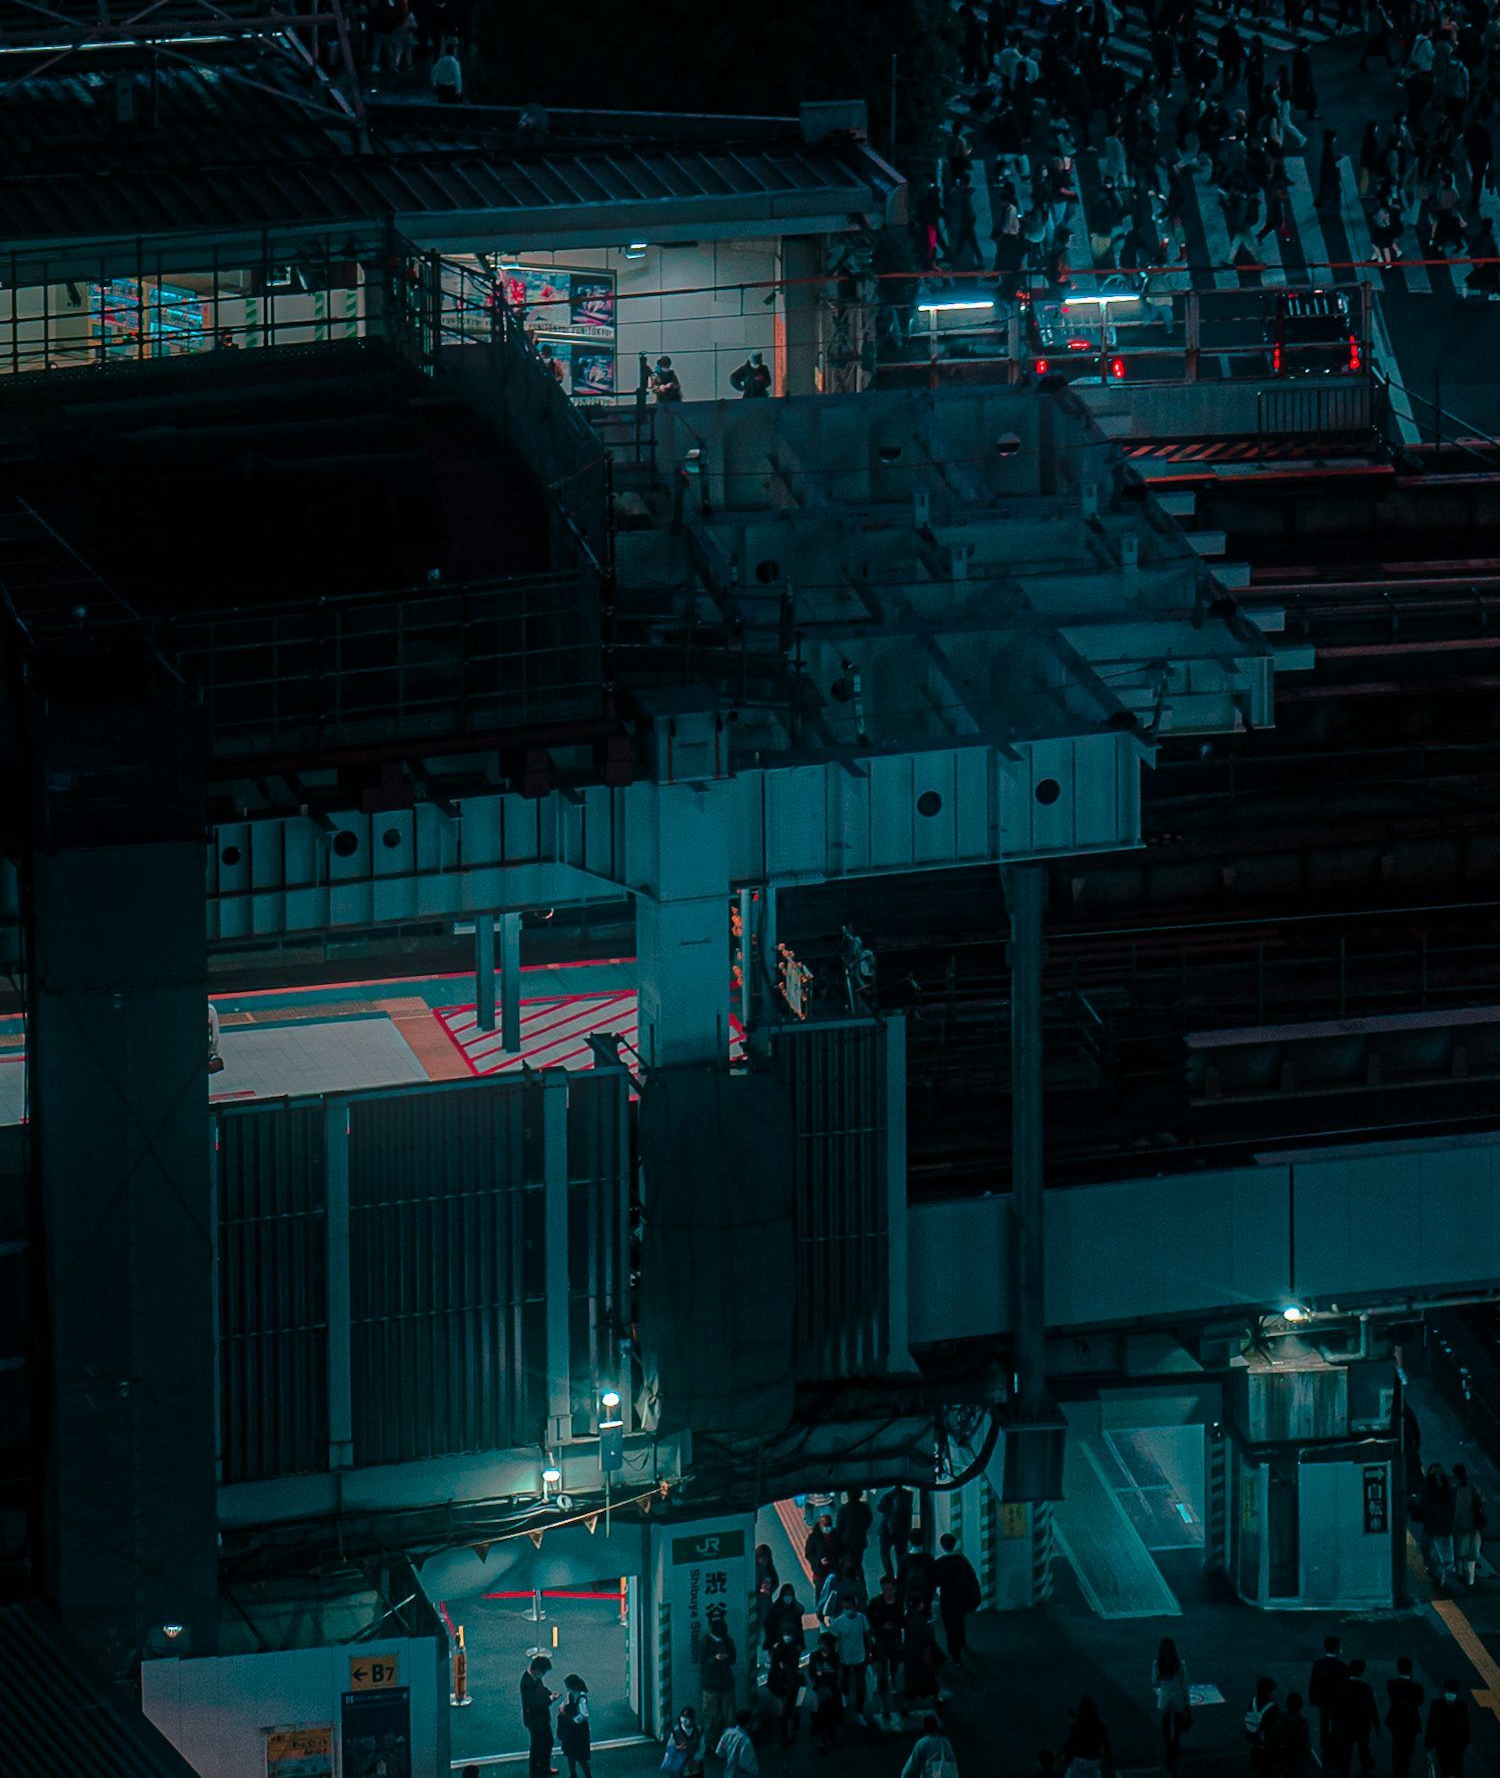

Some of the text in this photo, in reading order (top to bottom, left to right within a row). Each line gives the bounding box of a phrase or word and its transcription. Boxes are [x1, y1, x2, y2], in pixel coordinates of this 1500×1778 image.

[697, 1536, 721, 1553] JR
[690, 1568, 700, 1615] Shibuya
[372, 1663, 396, 1683] B7
